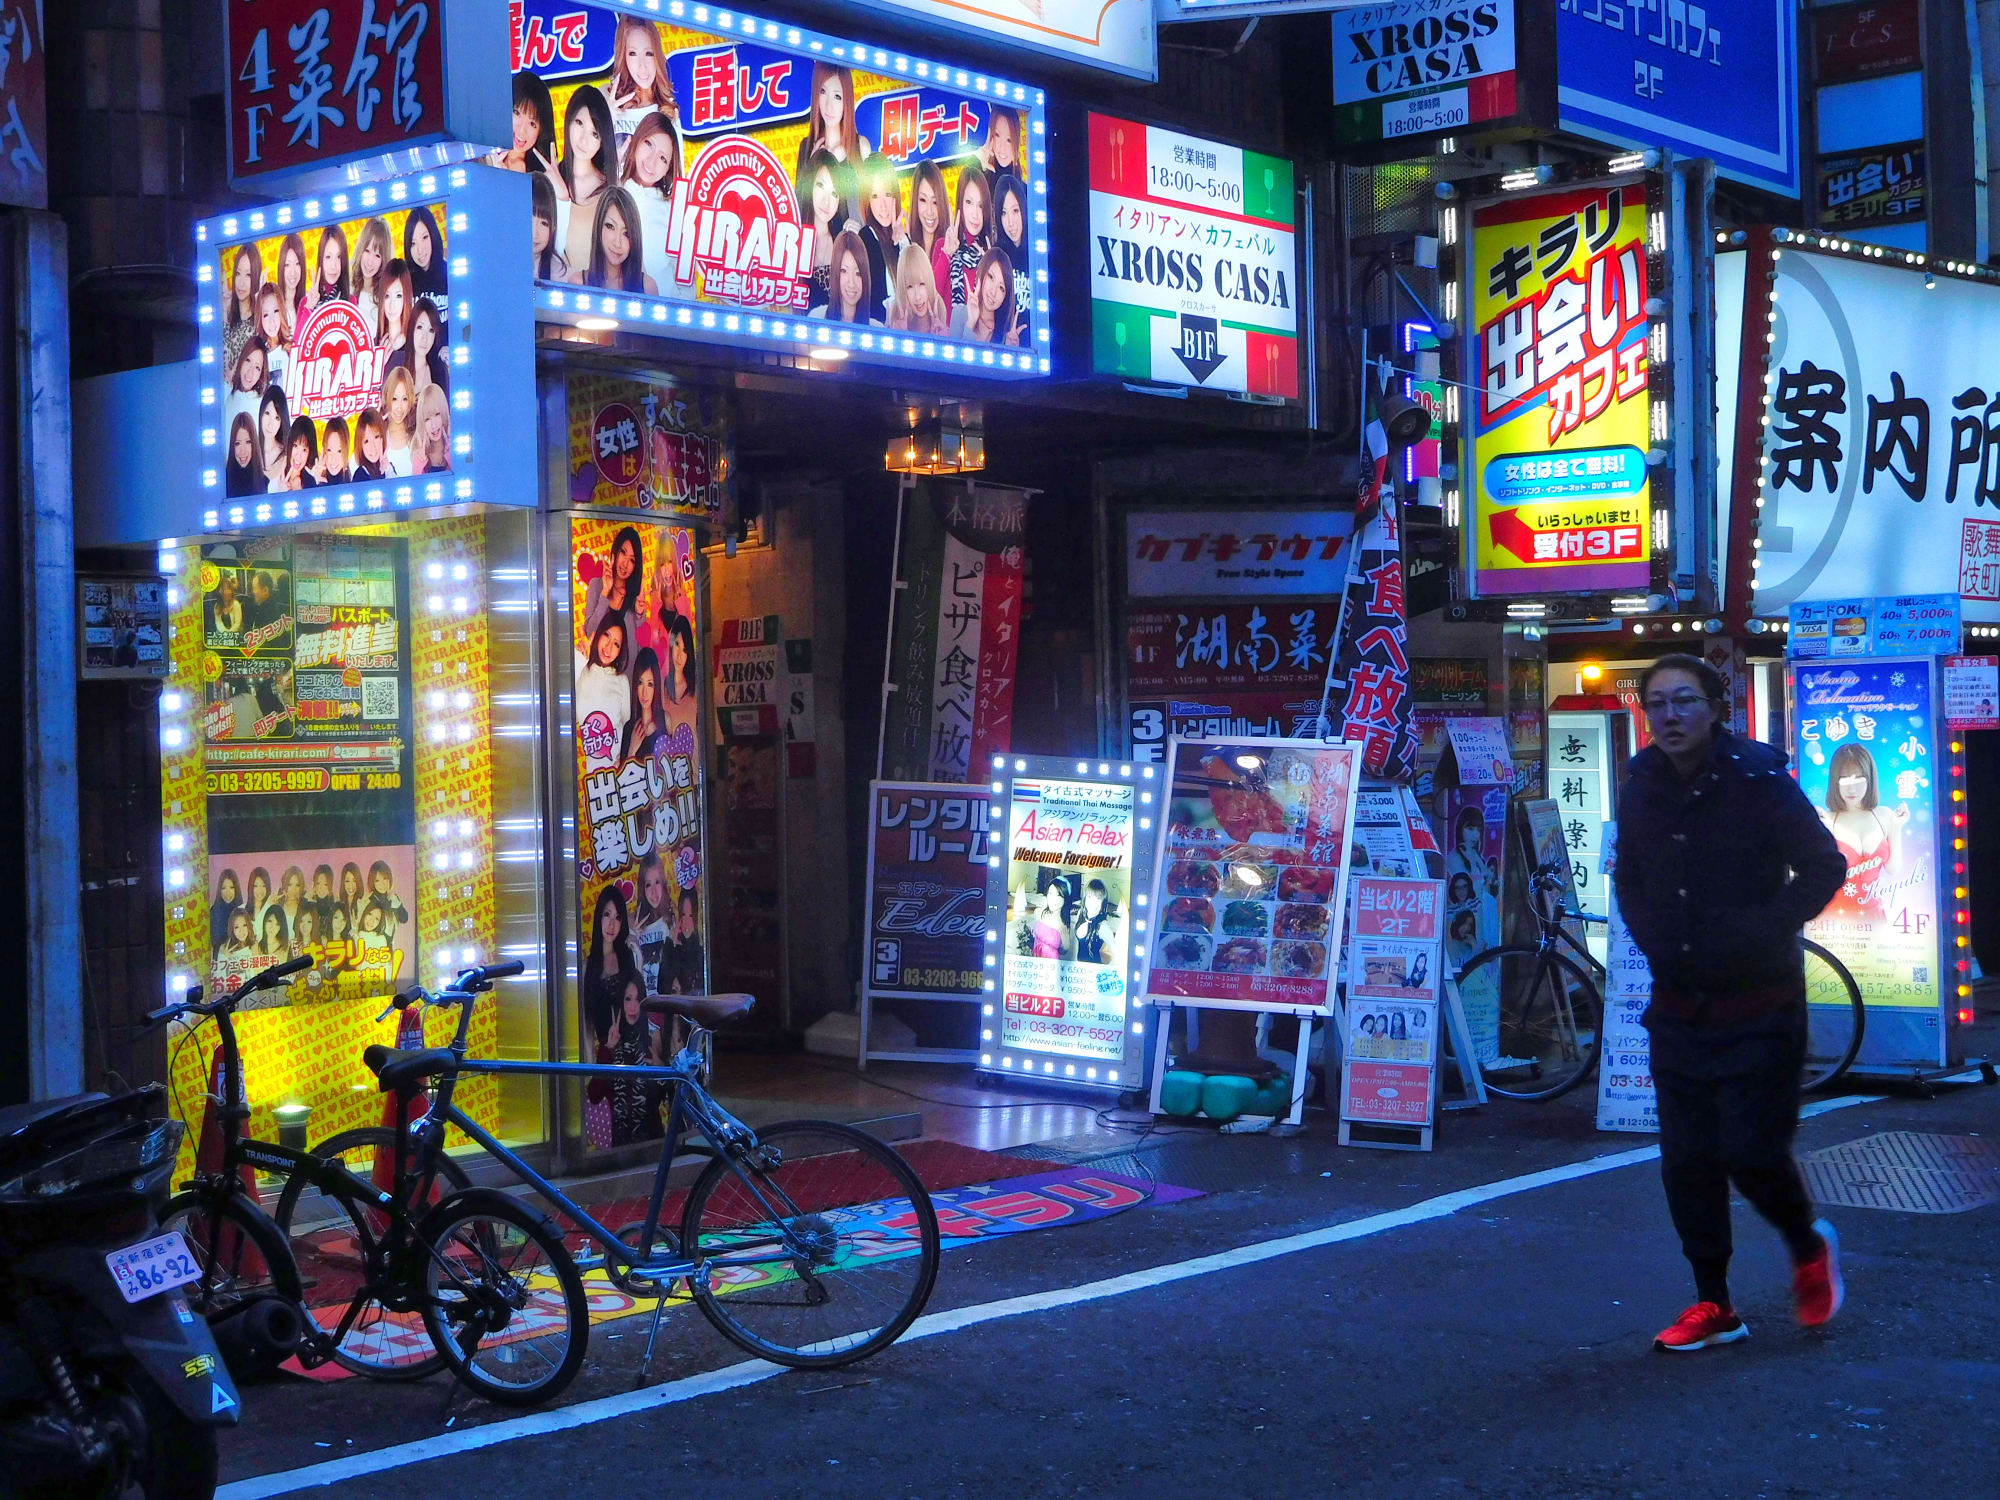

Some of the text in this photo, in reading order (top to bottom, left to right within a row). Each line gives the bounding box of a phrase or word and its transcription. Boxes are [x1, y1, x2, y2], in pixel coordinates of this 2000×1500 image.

[1348, 3, 1499, 64] XROSS
[1366, 43, 1484, 94] CASA
[1634, 59, 1664, 100] 2F
[693, 49, 791, 126] 話して
[1408, 97, 1441, 114] 営業時間
[880, 96, 979, 159] 即デート
[1173, 144, 1218, 172] 営業時間
[697, 152, 788, 215] community cafe
[1150, 163, 1241, 204] 18:00~5:00
[1827, 152, 1913, 208] 出会い
[1888, 177, 1923, 198] カフェ
[1884, 198, 1921, 217] 3F
[667, 178, 815, 282] KIRARI
[1113, 204, 1277, 257] イタリアン×カフェバル
[1488, 187, 1623, 302] キラリ
[1096, 235, 1204, 294] XROSS
[1213, 257, 1291, 310] CASA
[705, 267, 810, 310] 出会いカフェ
[304, 309, 366, 357] community cafe
[1183, 327, 1217, 363] B1F
[1486, 247, 1643, 414] 出会い
[287, 346, 385, 416] KIRARI
[1547, 341, 1649, 447] カフェ
[307, 390, 383, 417] 出会いカフェ
[639, 392, 688, 428] すべて
[595, 417, 640, 460] 女性
[1770, 360, 2000, 508] 案内所
[622, 453, 637, 478] は
[945, 495, 1025, 534] 本格派
[1532, 527, 1638, 560] 受付3F
[332, 606, 391, 624] パスポート
[1801, 603, 1863, 620] カードOK!
[1907, 608, 1954, 621] 5,000円
[244, 613, 293, 649] 2ショット
[739, 618, 762, 641] B1F
[1175, 605, 1343, 674] 湖南菜
[1801, 624, 1824, 634] VISA
[1907, 629, 1951, 642] 7,000円
[345, 655, 399, 669] いたします。
[720, 660, 776, 684] XROSS
[296, 673, 344, 687] ココだけの
[724, 682, 767, 705] CASA
[976, 651, 993, 740] クロスカーサ
[1441, 690, 1481, 701] ヒーリング
[251, 704, 297, 739] 即デート
[579, 718, 602, 737] すぐ
[1800, 716, 1878, 742] こゆき
[206, 746, 330, 762] http://cafe-kirari.com/
[582, 728, 620, 757] 行ける!
[219, 771, 324, 793] 03-3205-9997
[331, 772, 401, 791] OPEN 24:00
[1895, 735, 1928, 800] 小雪
[585, 754, 691, 827] 出会いを
[1043, 784, 1132, 800] タイ古式マッサージ
[1043, 796, 1133, 812] Traditional Thai Massage
[879, 795, 990, 831] レンタル
[1014, 809, 1129, 847] Asian Relax
[1040, 808, 1129, 825] アジアンリラックス
[591, 790, 698, 874] 楽しめ!!
[1013, 846, 1116, 869] Welcome Foreigner
[897, 881, 943, 897] エデン
[1359, 886, 1435, 915] 当ビル2階
[876, 886, 988, 939] Eden
[1380, 917, 1412, 935] 2F
[1893, 905, 1930, 935] 4F
[302, 938, 393, 970] キラリなら
[876, 941, 899, 983] 3F
[1250, 983, 1314, 996] 03-3207-8288
[1820, 981, 1933, 997] 03-457-3885
[1006, 993, 1063, 1016] 当ビル2F
[1028, 1020, 1124, 1043] 03-3207-5527
[245, 1148, 297, 1169] TRANSPOINT
[127, 1242, 168, 1265] 新宿区
[127, 1253, 196, 1297] み 86-92
